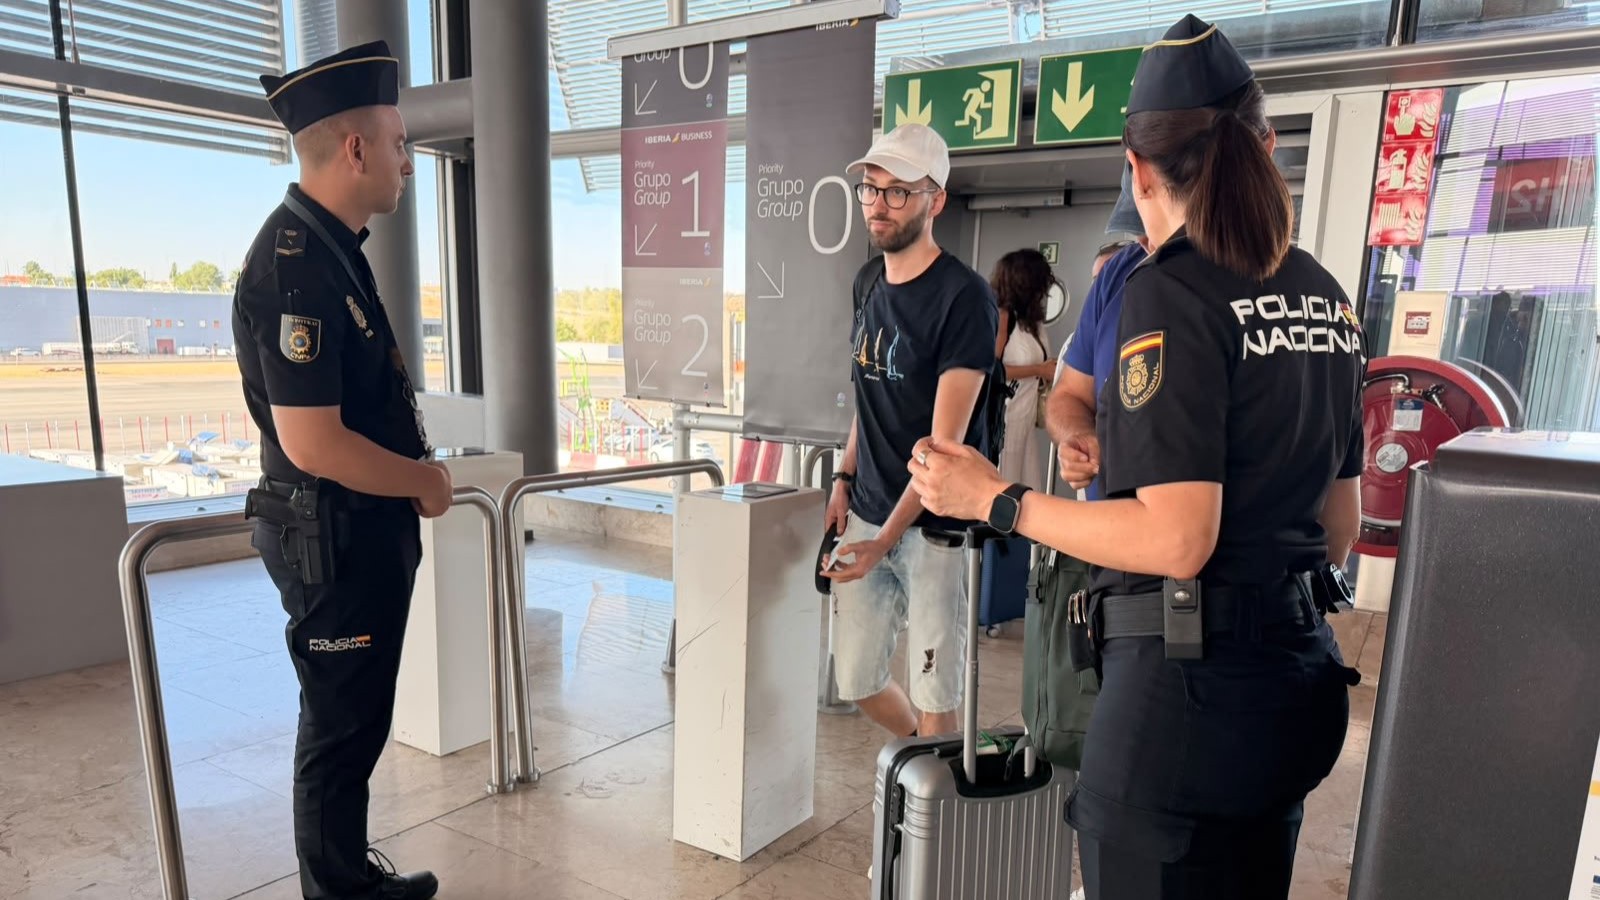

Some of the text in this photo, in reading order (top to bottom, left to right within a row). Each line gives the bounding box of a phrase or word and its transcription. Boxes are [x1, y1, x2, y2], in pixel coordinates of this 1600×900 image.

[644, 130, 713, 144] IBERIA BUSINESS
[759, 163, 784, 175] Priority
[633, 171, 671, 191] Grupo
[757, 177, 804, 200] Grupo
[633, 189, 671, 208] Group
[681, 170, 710, 237] 1
[757, 198, 804, 222] Group
[808, 175, 852, 254] 0
[633, 309, 672, 329] Grupo
[633, 326, 672, 347] Group
[681, 313, 709, 377] 2
